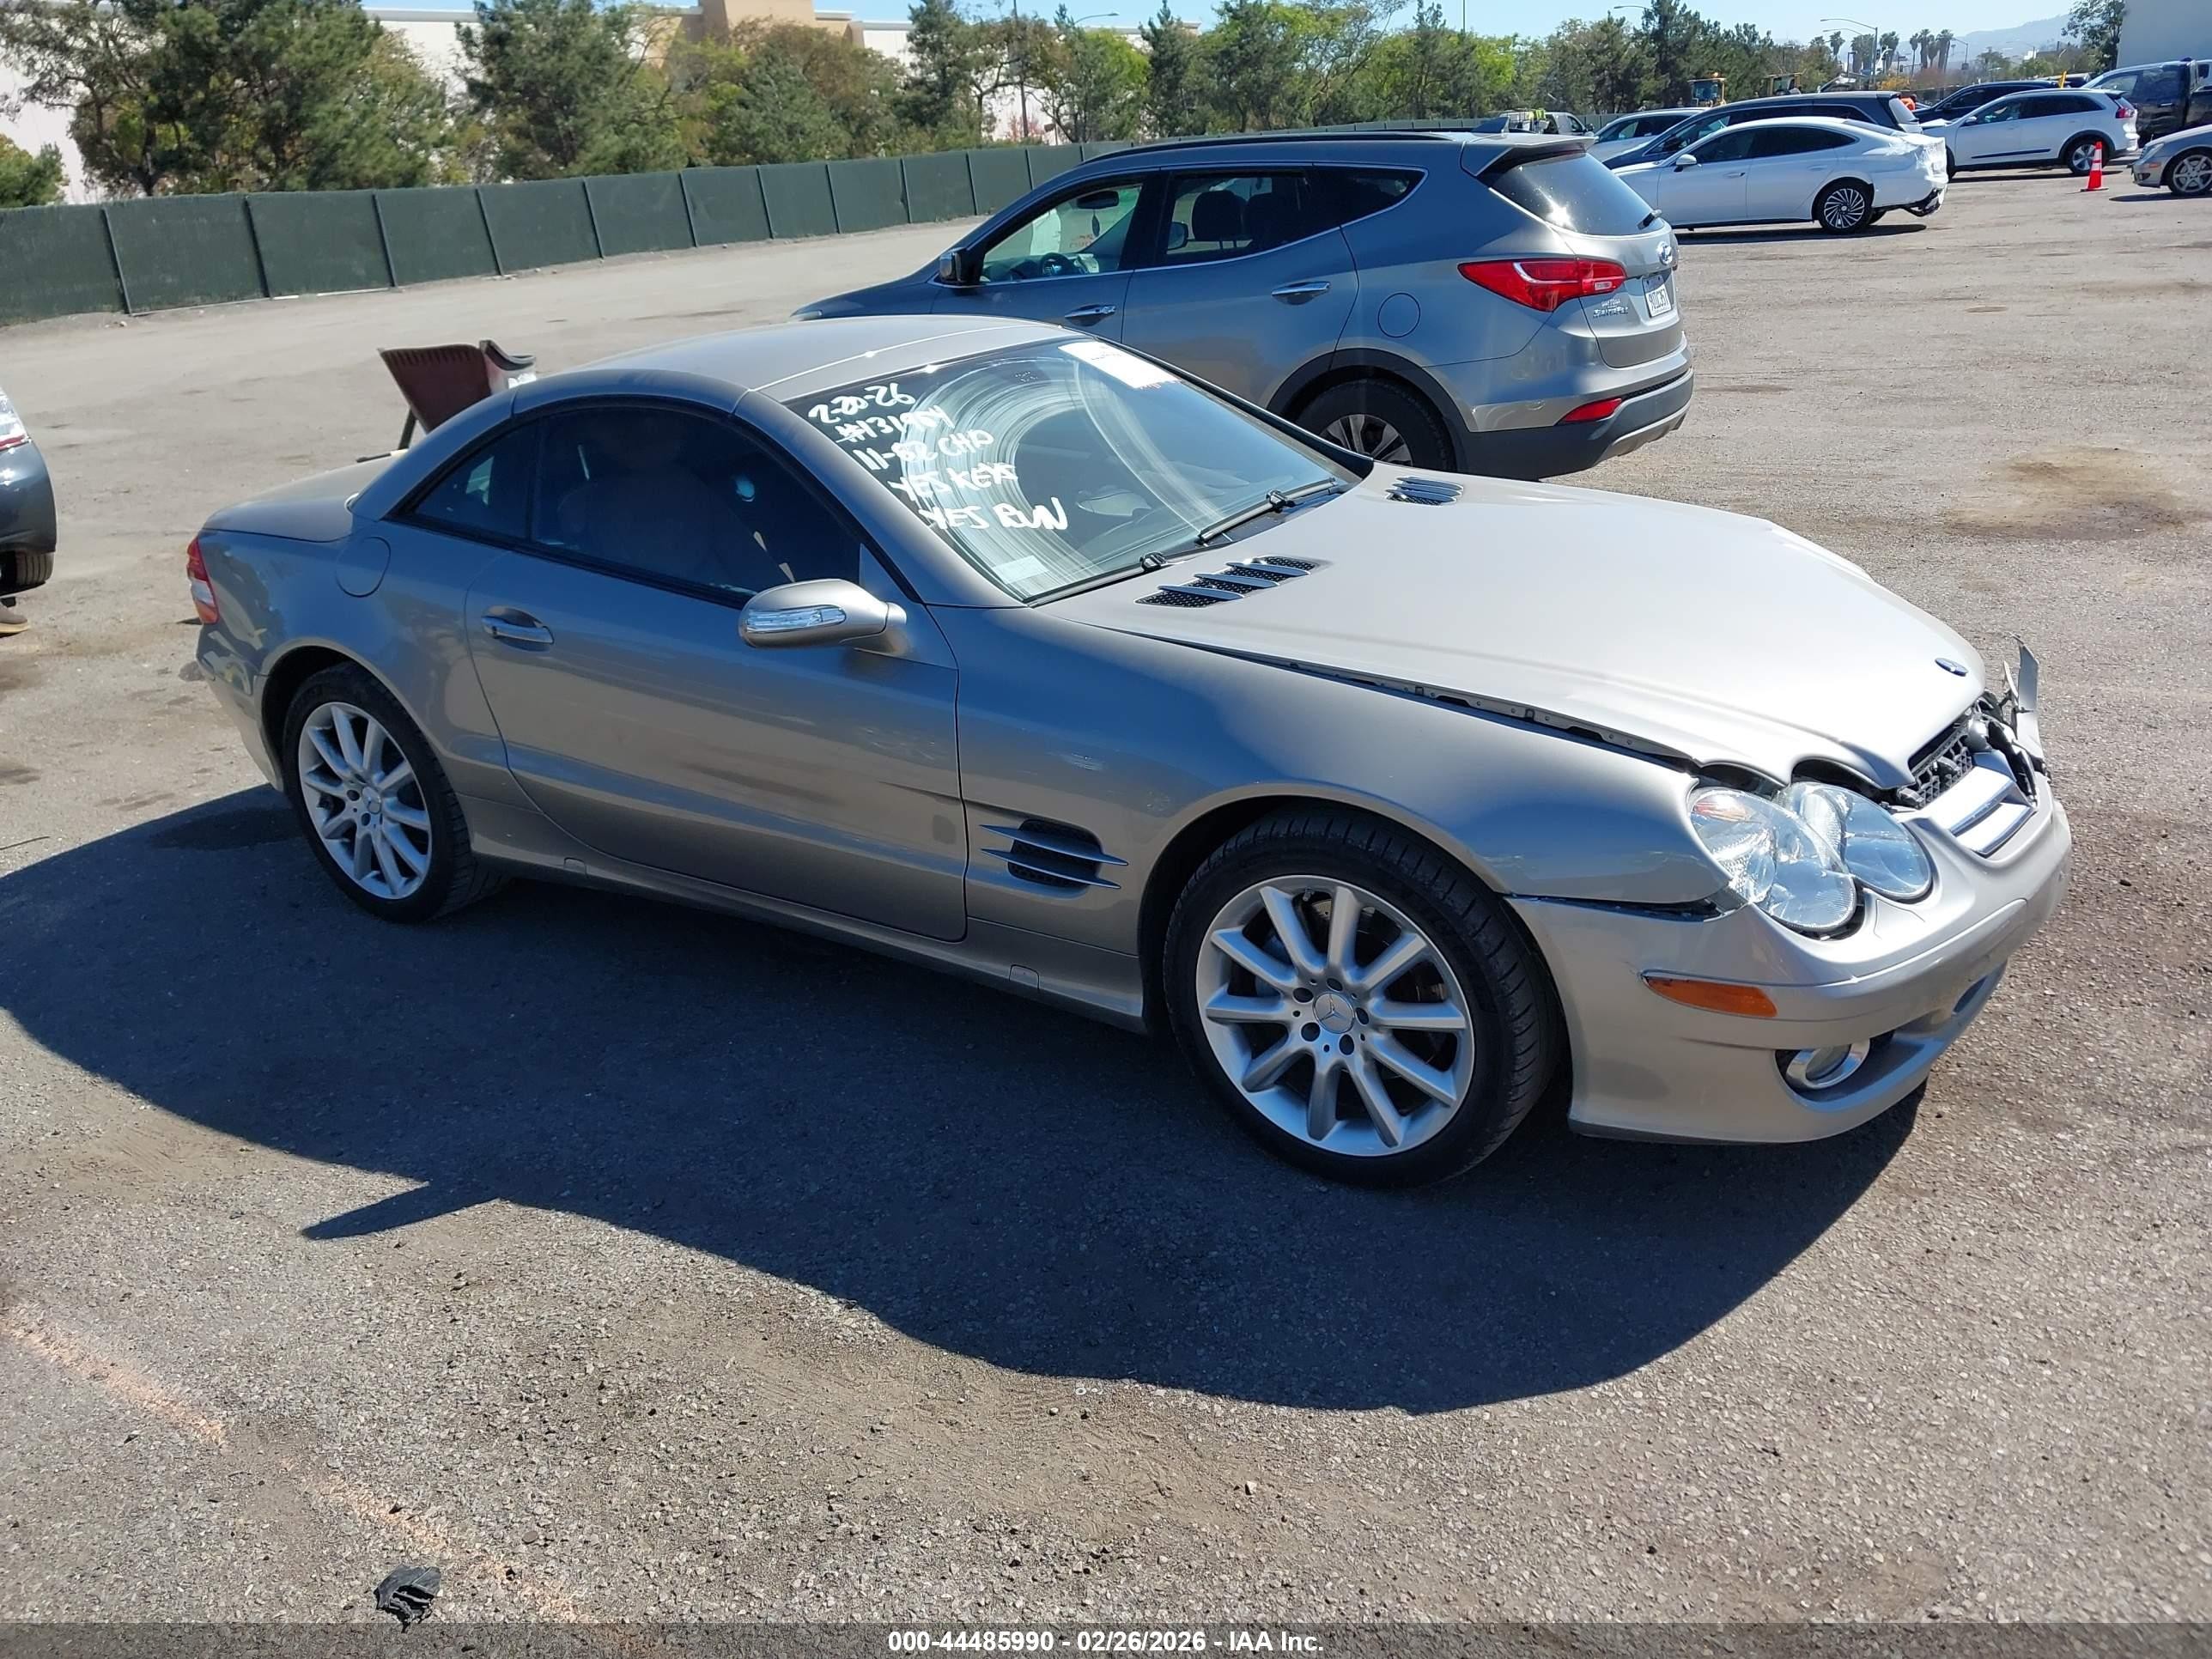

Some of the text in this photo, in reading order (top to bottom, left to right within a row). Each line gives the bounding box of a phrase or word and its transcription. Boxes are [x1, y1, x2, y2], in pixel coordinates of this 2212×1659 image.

[887, 461, 1018, 501] YES KEYS
[918, 496, 1068, 530] YES RUN
